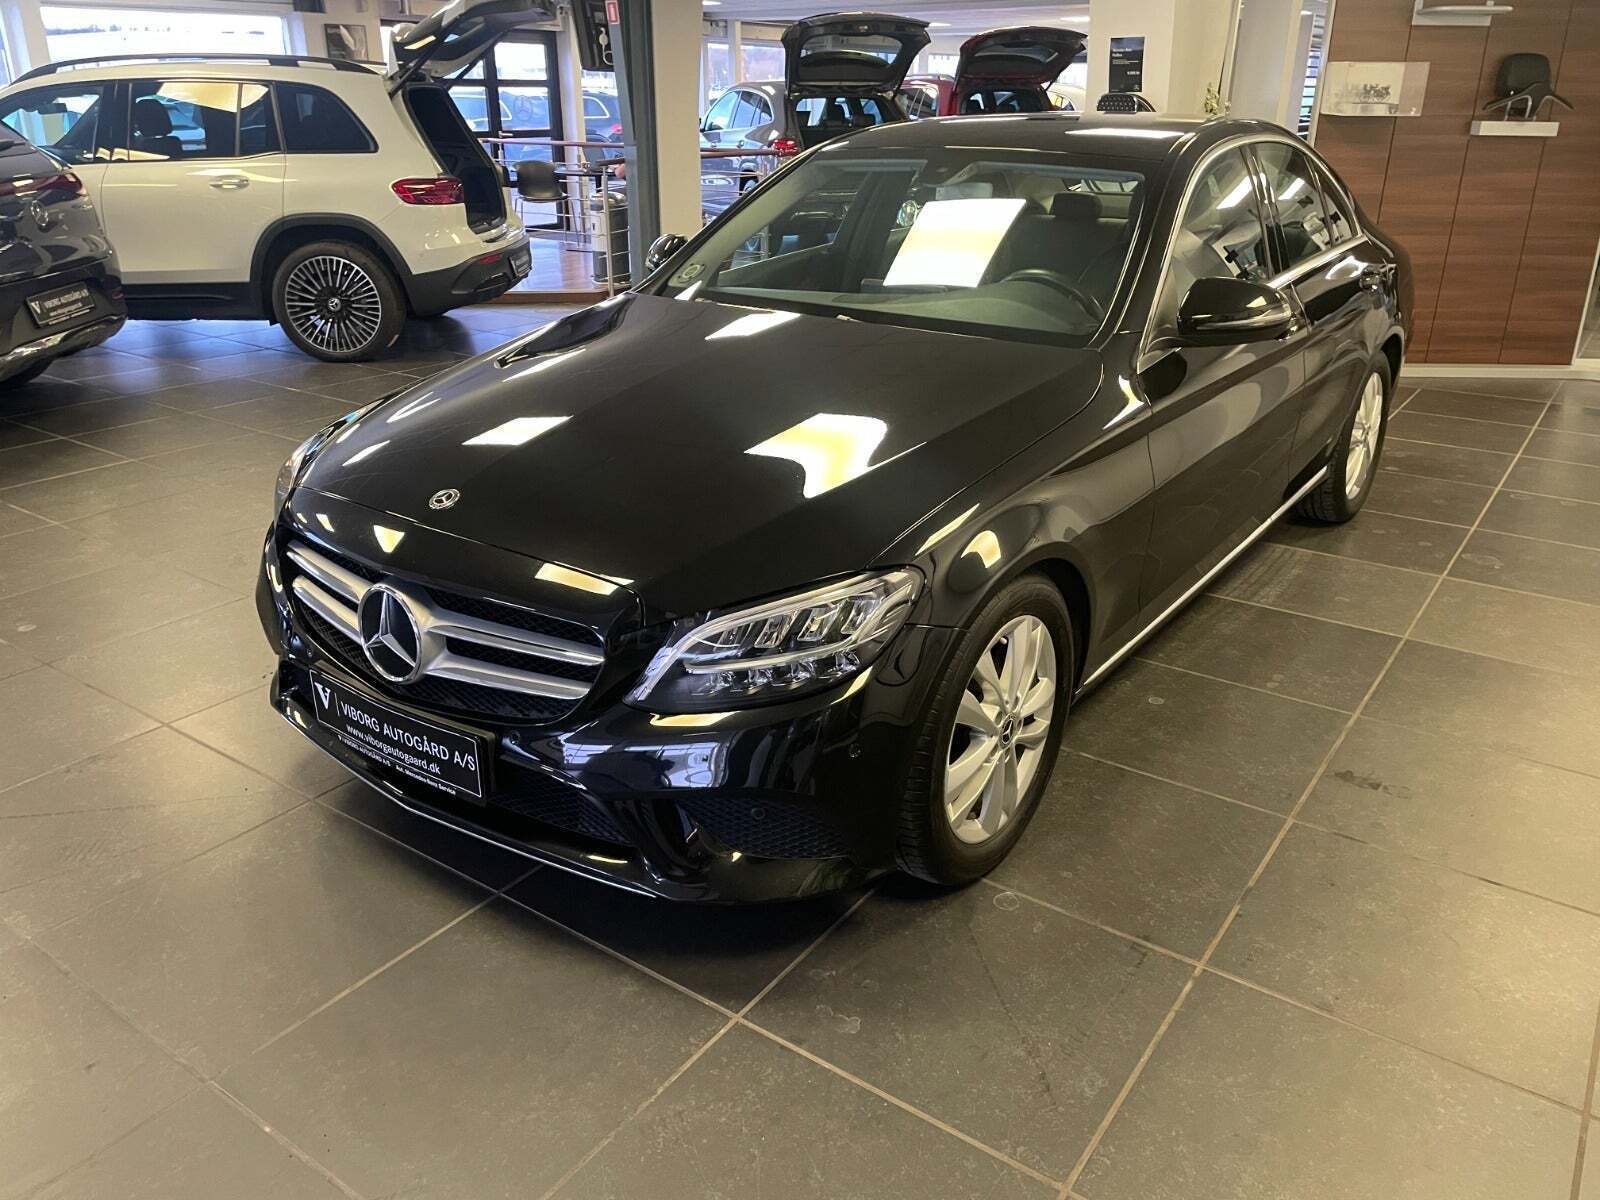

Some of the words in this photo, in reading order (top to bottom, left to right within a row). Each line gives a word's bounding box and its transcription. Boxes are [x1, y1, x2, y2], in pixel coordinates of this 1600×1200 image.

[340, 701, 380, 732] VIBORG
[383, 722, 449, 761] AUTOGÅRD
[453, 750, 476, 772] A/S
[346, 724, 441, 775] www.viborgautogaard.dk
